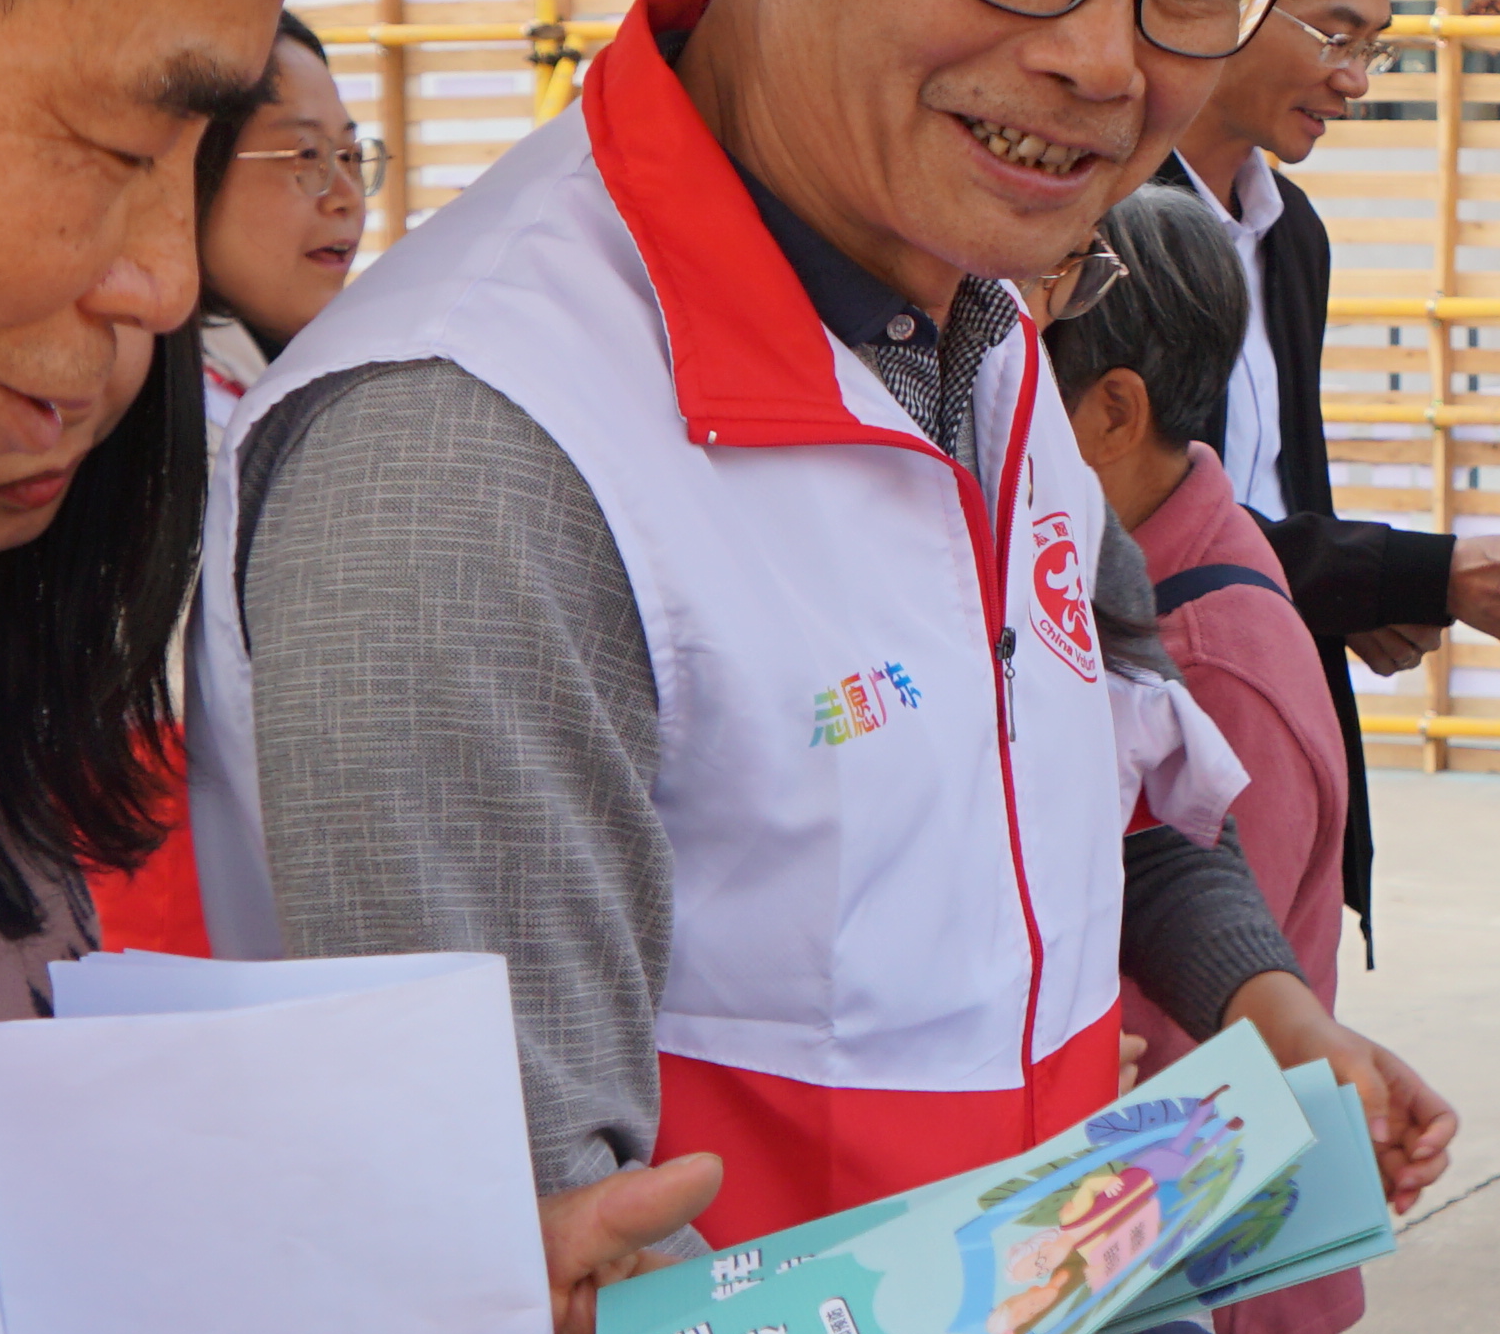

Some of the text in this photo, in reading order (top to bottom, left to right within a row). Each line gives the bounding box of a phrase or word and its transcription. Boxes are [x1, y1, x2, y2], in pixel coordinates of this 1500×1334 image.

[1039, 619, 1073, 657] China
[809, 660, 922, 749] 志愿广东
